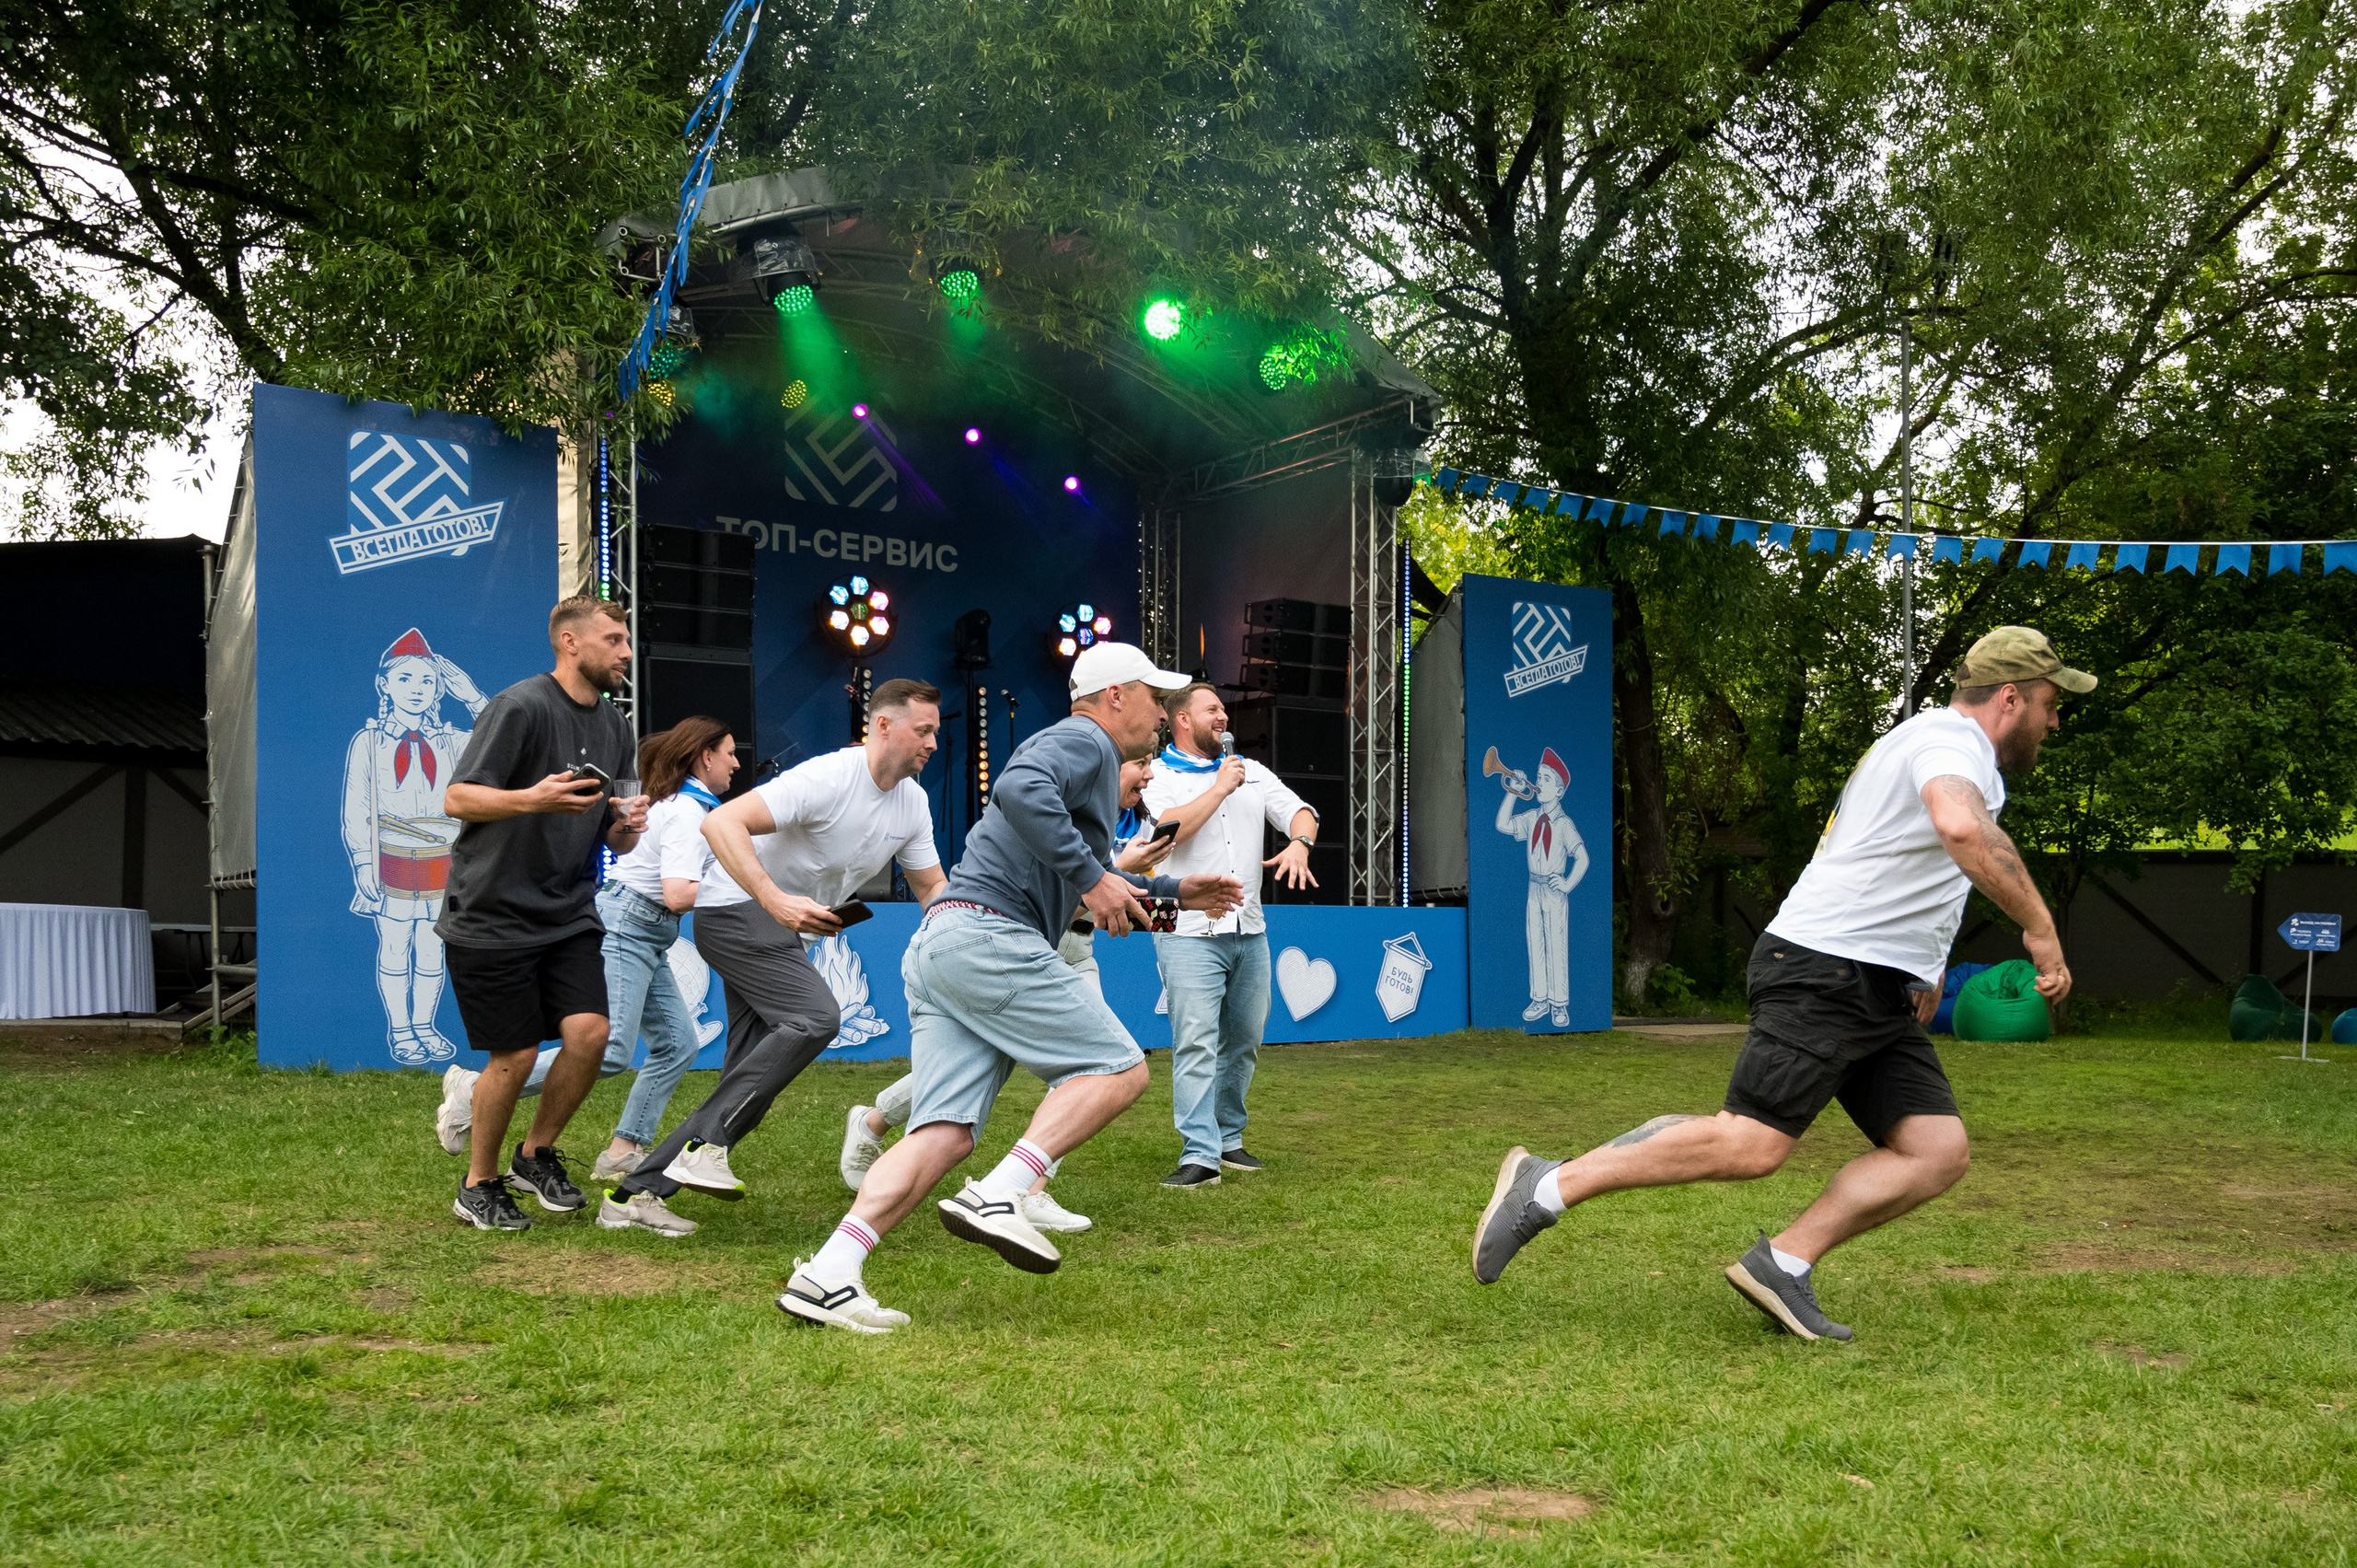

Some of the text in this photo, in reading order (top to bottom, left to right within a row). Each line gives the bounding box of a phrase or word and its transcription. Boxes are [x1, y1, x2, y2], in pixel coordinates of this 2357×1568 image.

[351, 515, 490, 562] ВСЕГДА ГОТОВ!
[716, 516, 958, 573] ТОП-СЕРВИС
[1515, 655, 1581, 688] ВСЕГДА ГОТОВ!
[1385, 976, 1414, 995] ГОТОВ!
[1391, 967, 1412, 983] БУДЬ
